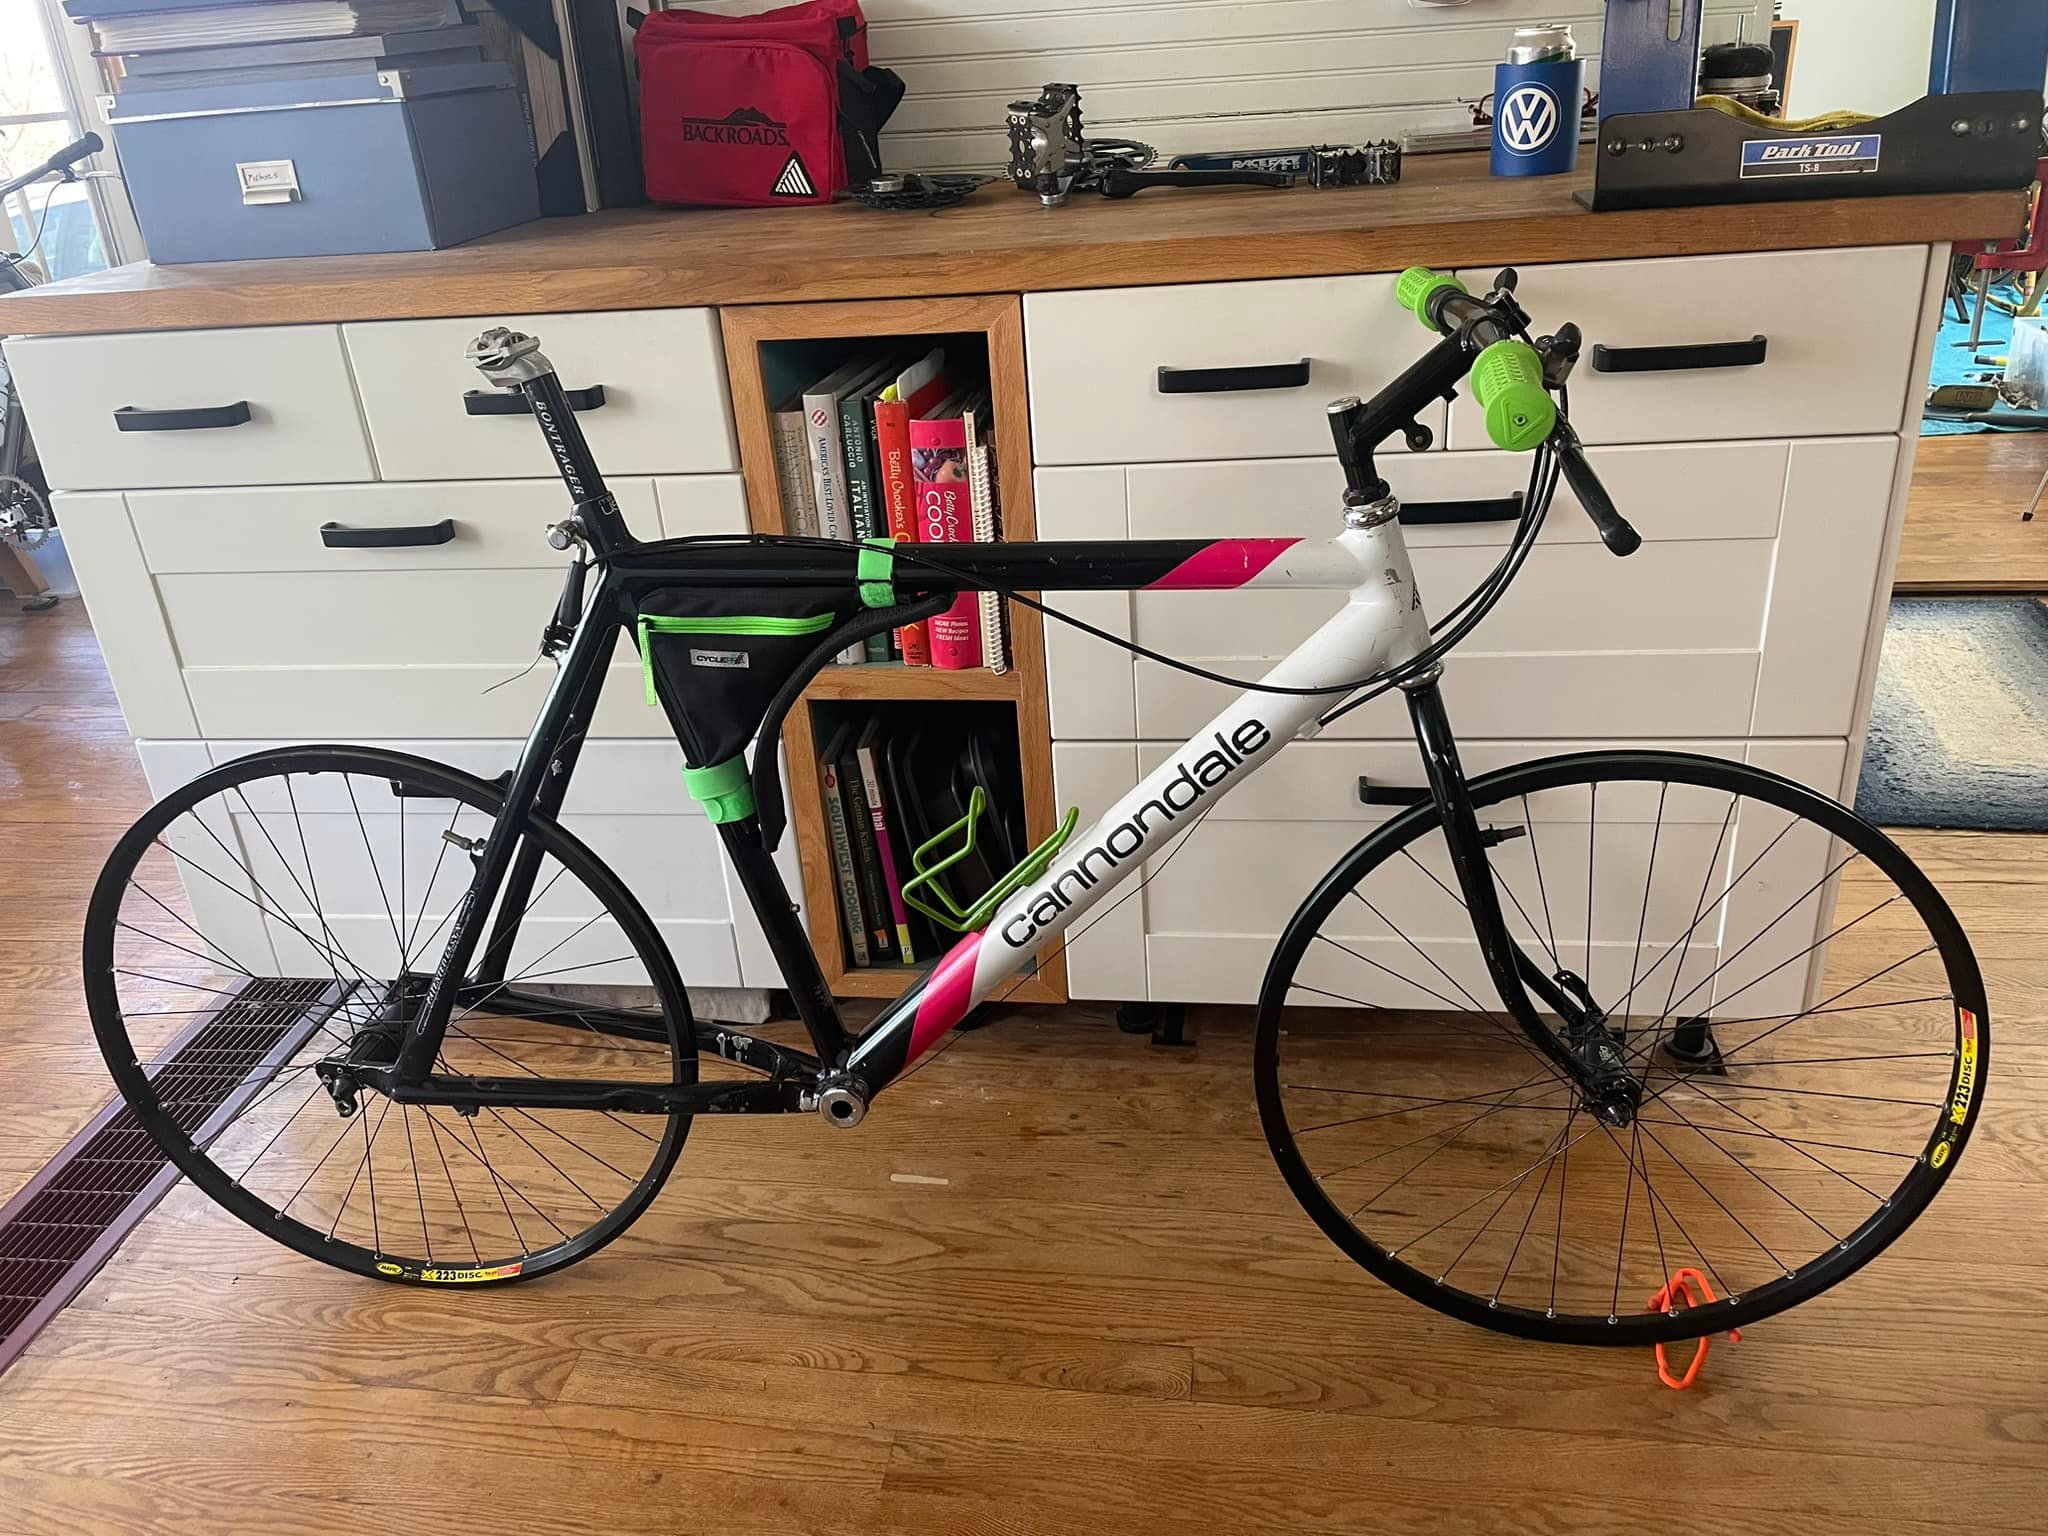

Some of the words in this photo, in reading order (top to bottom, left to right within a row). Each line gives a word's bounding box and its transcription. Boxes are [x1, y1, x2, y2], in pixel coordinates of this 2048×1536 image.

[1761, 145, 1812, 160] Park
[1814, 141, 1861, 157] Tool
[1800, 163, 1819, 172] TS-8
[535, 400, 584, 494] BONTRAGER
[843, 414, 856, 468] CARLUCCIO
[851, 421, 863, 463] ANTONIO
[888, 448, 902, 479] Betty
[851, 480, 866, 539] ITALIAN
[891, 480, 906, 529] Crocker's
[943, 490, 957, 516] Betty
[1001, 719, 1271, 949] cannondale
[828, 797, 852, 875] SOUTHWEST
[844, 879, 862, 934] COOKING
[1961, 1056, 1973, 1084] DISC
[457, 1271, 483, 1279] DISC
